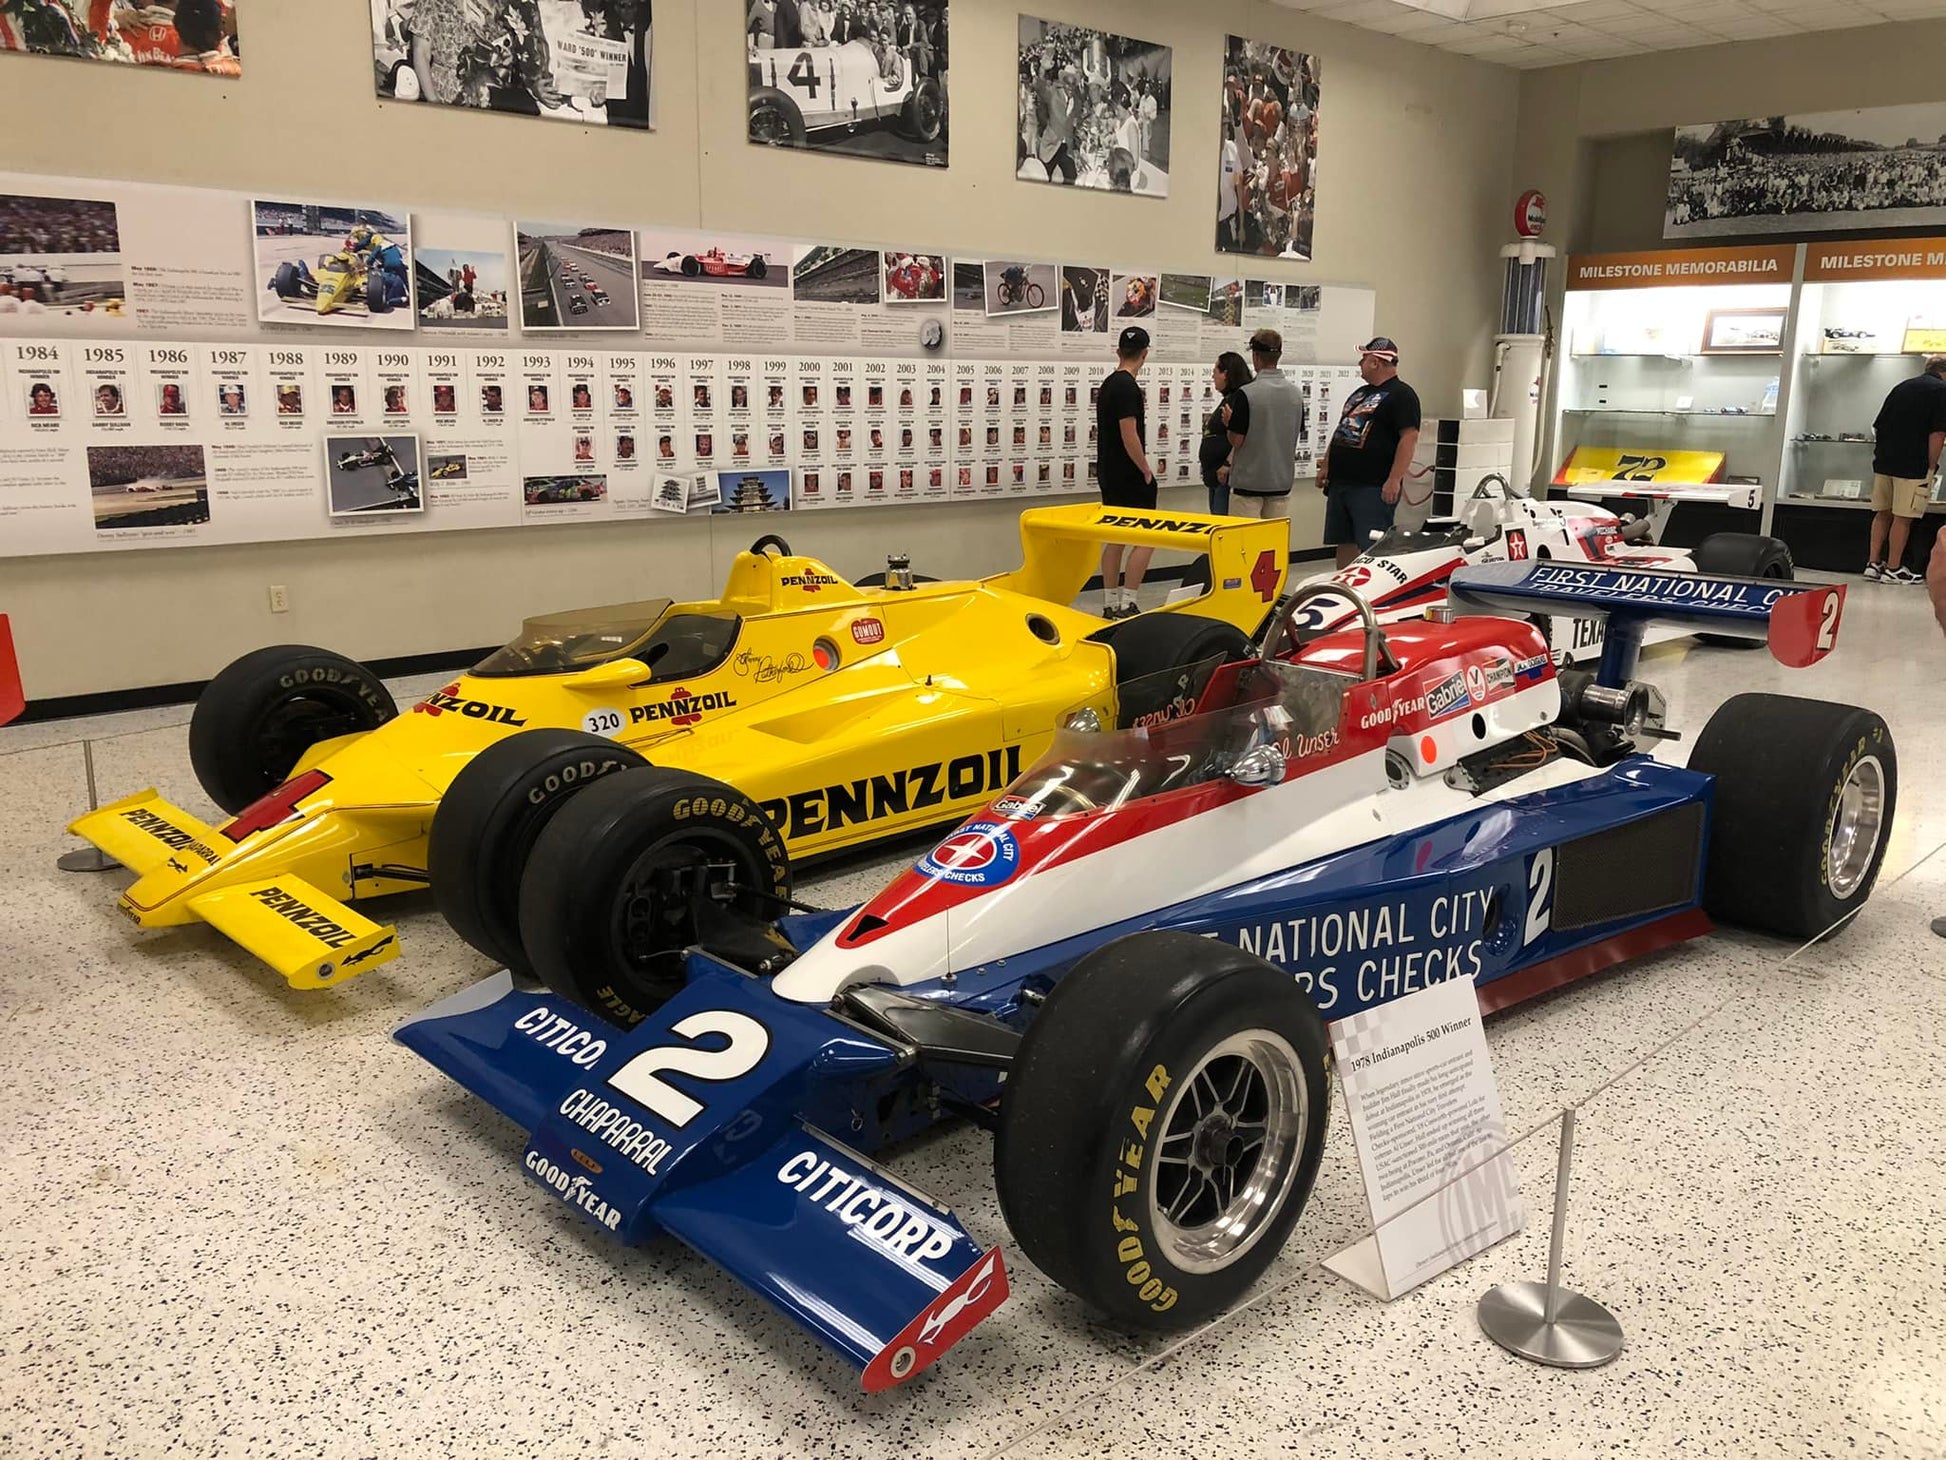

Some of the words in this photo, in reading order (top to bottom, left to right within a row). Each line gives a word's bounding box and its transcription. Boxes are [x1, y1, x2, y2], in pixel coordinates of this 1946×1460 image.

[600, 51, 627, 62] WINNER
[787, 52, 821, 99] 4
[1821, 253, 1922, 269] MILESTONE
[1580, 264, 1662, 279] MILESTONE
[1665, 259, 1777, 275] MEMORABILIA
[17, 346, 59, 361] 1984
[85, 348, 124, 362] 1985
[149, 349, 188, 364] 1986
[211, 351, 247, 364] 1987
[269, 352, 304, 365] 1988
[325, 353, 357, 366] 1989
[378, 354, 409, 366] 1990
[428, 355, 457, 367] 1991
[476, 356, 505, 368] 1992
[523, 356, 551, 368] 1993
[567, 357, 594, 369] 1994
[610, 358, 635, 370] 1995
[650, 358, 675, 370] 1996
[690, 359, 714, 371] 1997
[728, 360, 751, 372] 1998
[764, 361, 786, 372] 1999
[798, 362, 821, 373] 2000
[832, 362, 853, 373] 2001
[865, 363, 886, 374] 2002
[897, 364, 916, 374] 2003
[927, 364, 945, 374] 2004
[956, 365, 975, 375] 2005
[984, 365, 1002, 375] 2006
[1012, 365, 1029, 375] 2007
[1038, 366, 1055, 376] 2008
[1063, 366, 1080, 376] 2009
[1088, 366, 1104, 376] 2010
[1095, 515, 1216, 535] PENNZ
[1250, 550, 1281, 603] 4
[1377, 559, 1408, 584] STAR
[781, 576, 838, 587] PENNZOIL
[1530, 567, 1608, 587] FIRST
[1615, 574, 1748, 603] NATIONAL
[1817, 592, 1840, 650] 2
[1572, 618, 1605, 650] TEXA
[1426, 677, 1466, 714] Gabriel
[629, 691, 737, 724] PENNZOIL
[588, 713, 620, 733] 320
[945, 871, 985, 882] CHECKS
[1524, 847, 1554, 947] 2
[249, 886, 357, 949] PENNZOIL
[1239, 902, 1415, 963] NATIONAL
[1430, 886, 1494, 938] CITY
[1357, 940, 1482, 1002] CHECKS
[1350, 1054, 1370, 1071] 1978
[1372, 1033, 1426, 1066] Indianapolis
[1426, 1027, 1440, 1041] 500
[1441, 1015, 1471, 1035] Winner
[607, 1010, 769, 1128] 2
[559, 1089, 673, 1176] CHAPARRAL
[526, 1151, 621, 1231] GOODYEAR
[1113, 1064, 1178, 1312] GOODYEAR
[778, 1151, 953, 1264] CITICORP
